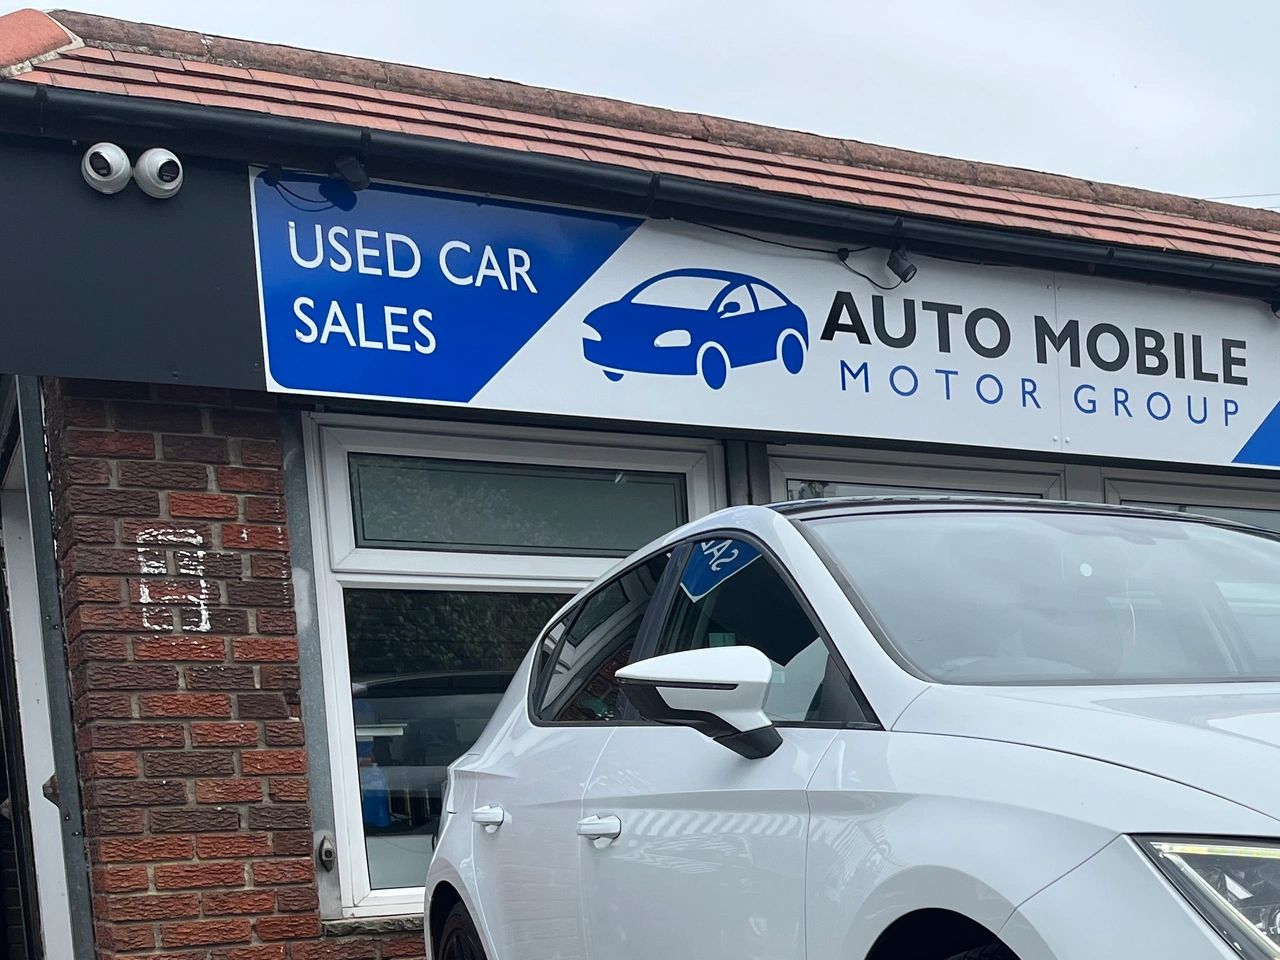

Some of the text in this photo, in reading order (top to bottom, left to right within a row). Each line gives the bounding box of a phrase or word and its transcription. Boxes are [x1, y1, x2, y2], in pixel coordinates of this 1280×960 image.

[287, 221, 538, 293] USED CAR
[294, 297, 436, 354] SALES
[819, 290, 1249, 386] AUTO MOBILE
[839, 359, 1239, 427] MOTOR GROUP
